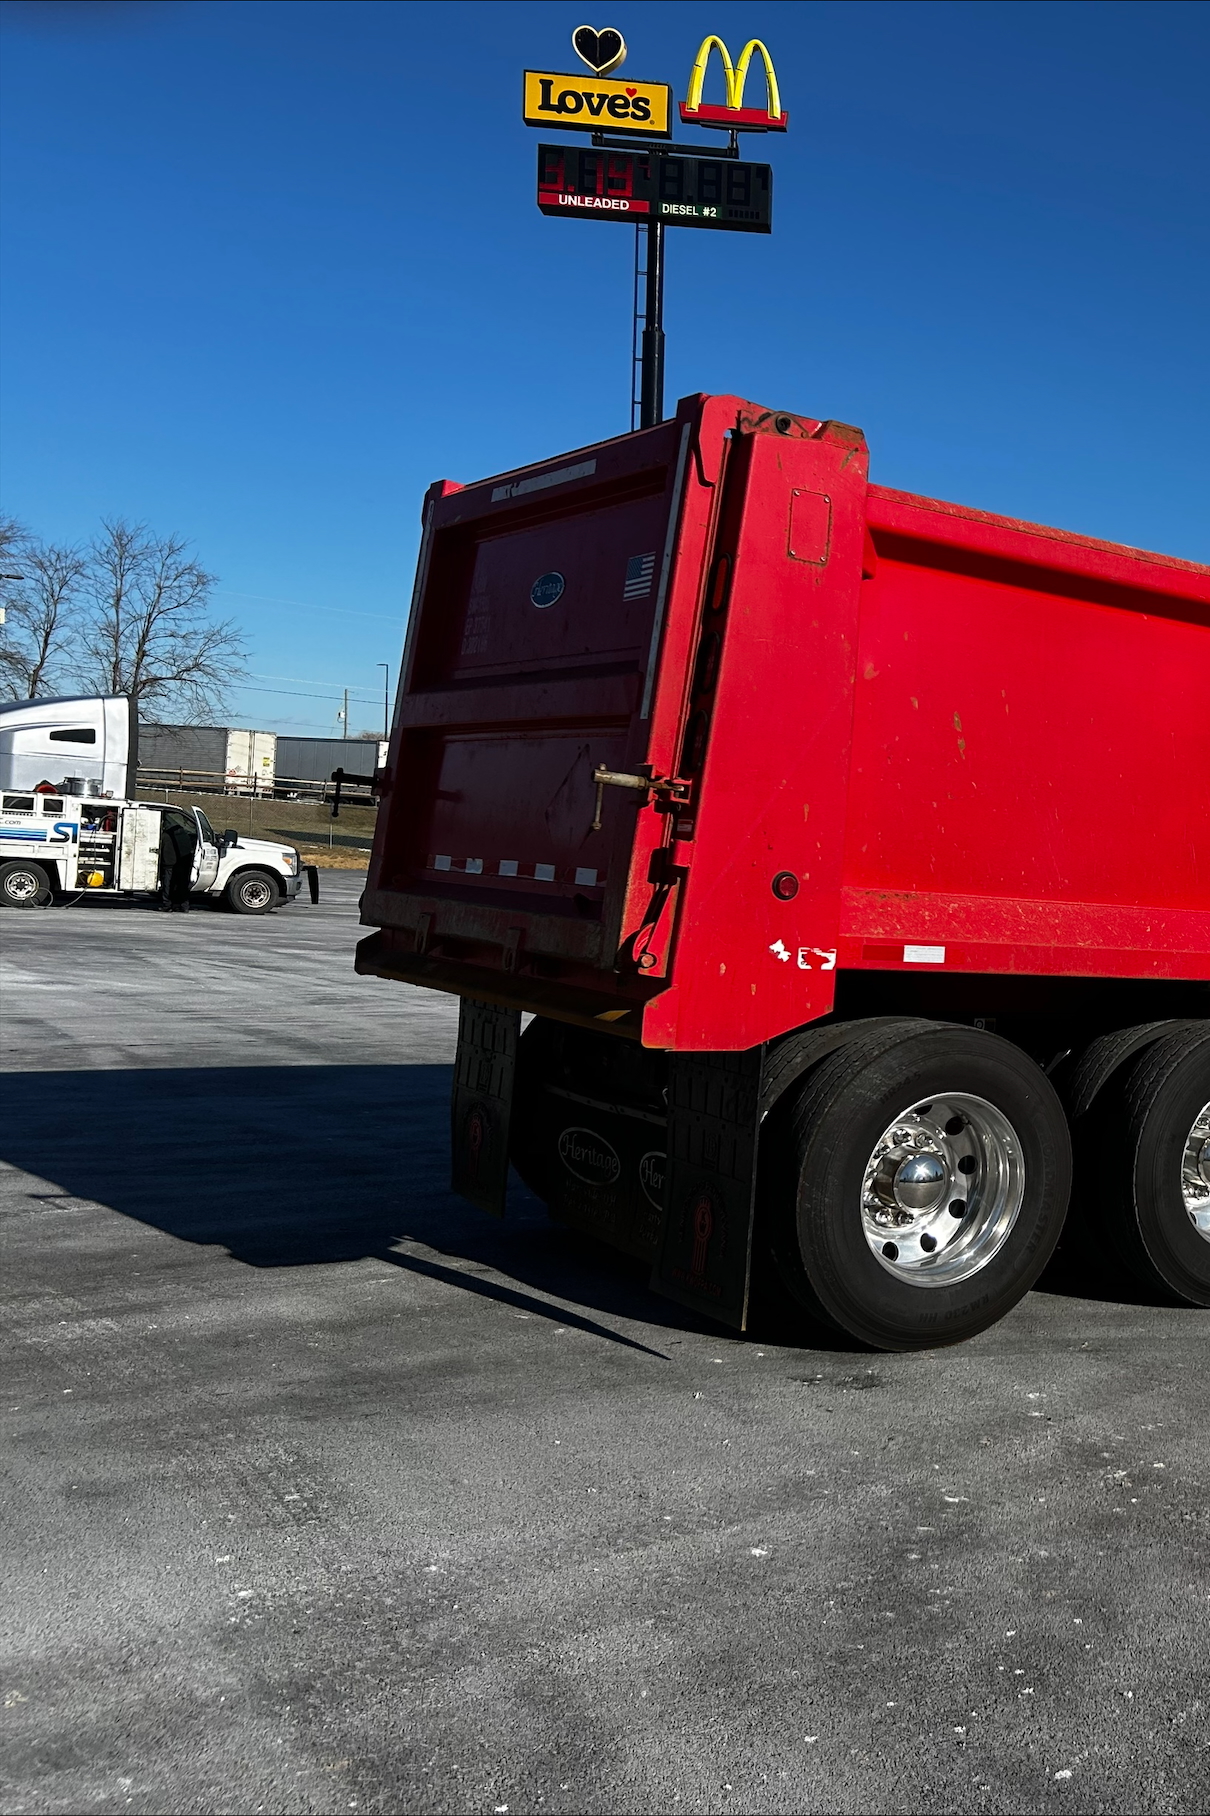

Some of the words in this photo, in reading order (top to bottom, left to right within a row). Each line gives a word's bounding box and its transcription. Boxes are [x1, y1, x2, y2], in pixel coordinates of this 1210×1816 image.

[558, 194, 630, 211] UNLEADED
[662, 204, 699, 217] DIESEL
[702, 206, 717, 218] #2
